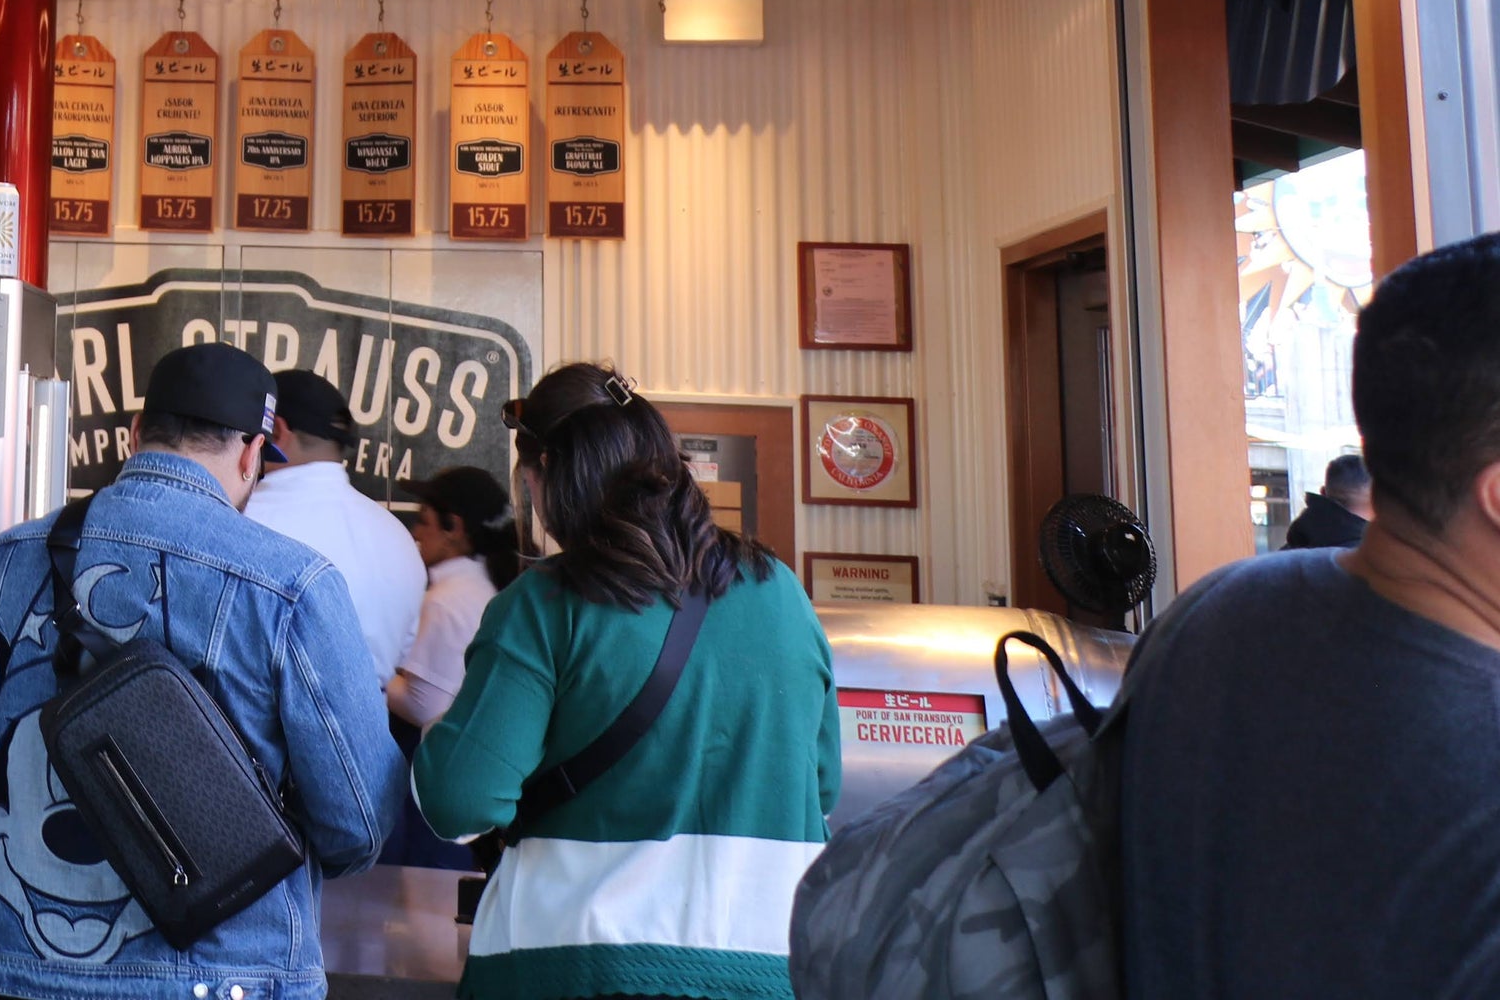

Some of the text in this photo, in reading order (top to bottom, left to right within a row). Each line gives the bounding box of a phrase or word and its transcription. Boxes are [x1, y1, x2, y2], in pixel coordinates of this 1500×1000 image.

[475, 151, 504, 162] GOLDEN
[478, 162, 500, 172] STOUT
[55, 201, 93, 222] 15.75
[156, 198, 196, 219] 15.75
[253, 198, 292, 219] 17.25
[358, 202, 396, 224] 15.75
[468, 206, 510, 228] 15.75
[565, 205, 607, 227] 15.75
[832, 566, 889, 580] WARNING
[884, 693, 932, 709] 生ビール
[856, 710, 964, 724] PORT OF SAN FRANSOKYO
[857, 723, 966, 746] CERVECERÍA
